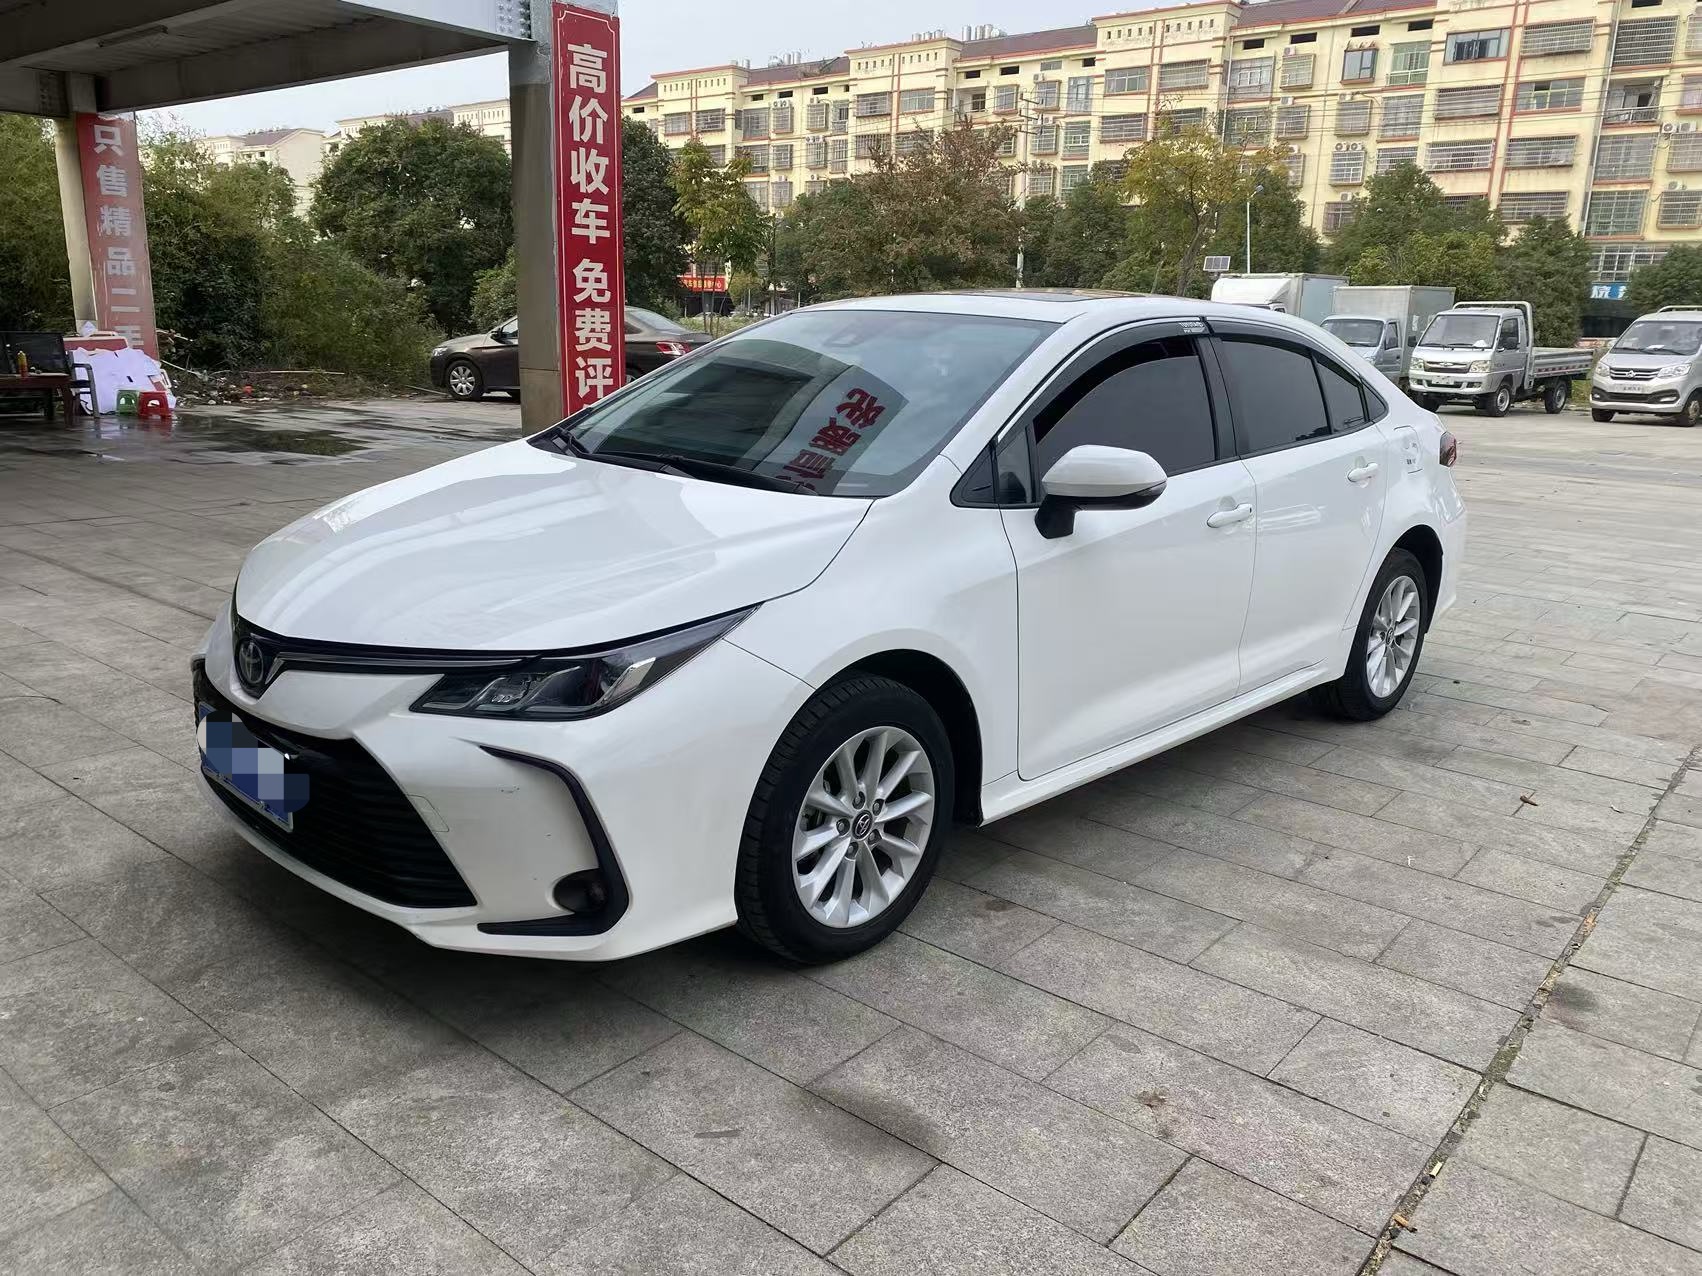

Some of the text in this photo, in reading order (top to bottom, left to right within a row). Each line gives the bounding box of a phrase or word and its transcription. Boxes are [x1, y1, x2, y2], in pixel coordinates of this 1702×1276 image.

[567, 43, 614, 408] 高价收车 免费评
